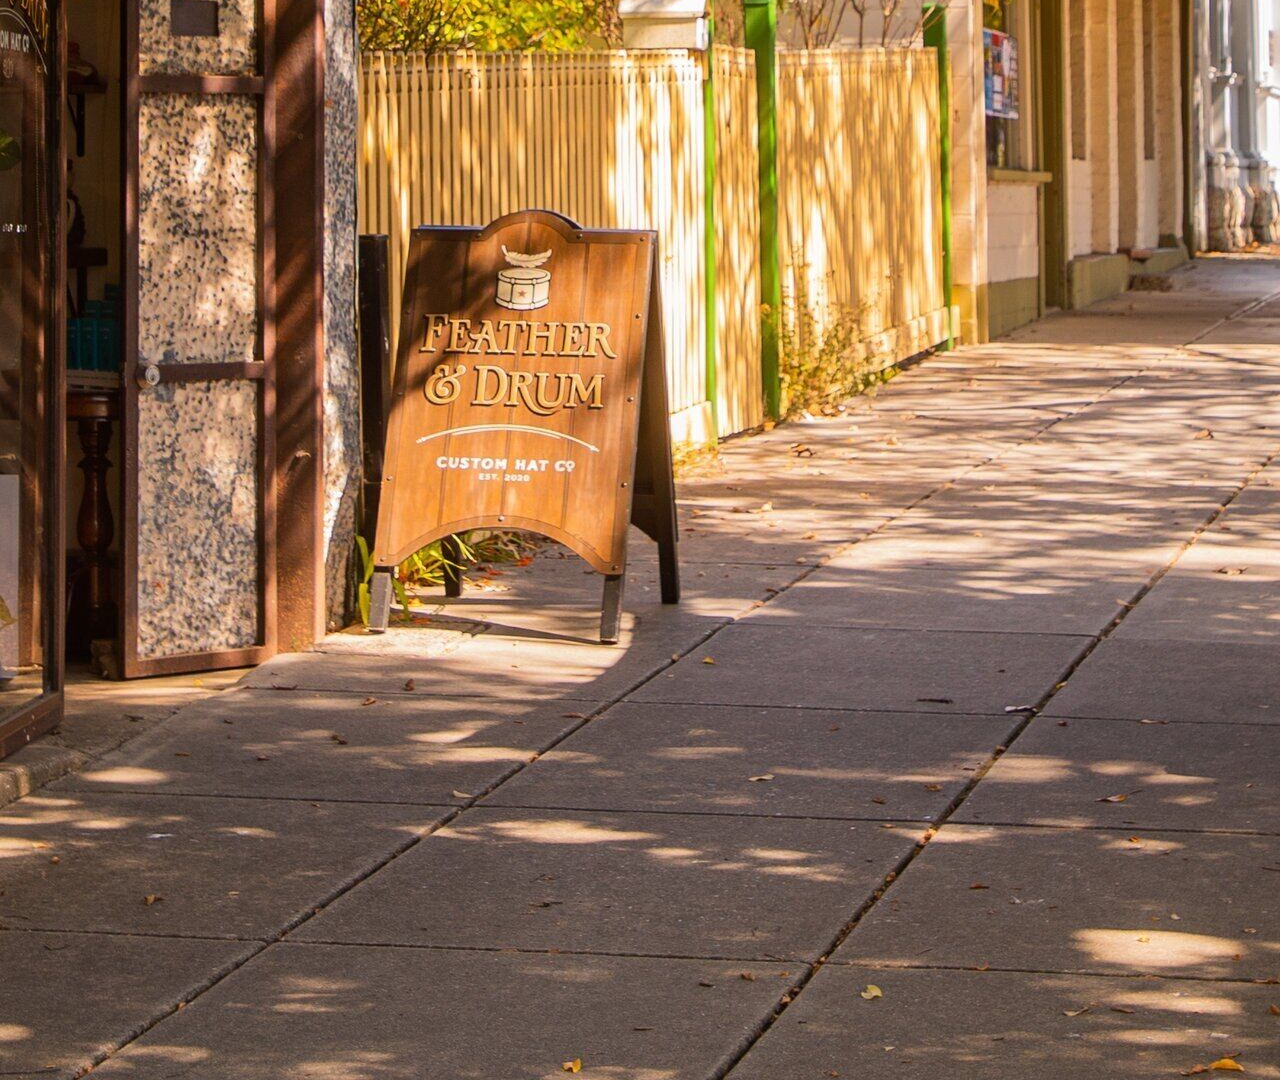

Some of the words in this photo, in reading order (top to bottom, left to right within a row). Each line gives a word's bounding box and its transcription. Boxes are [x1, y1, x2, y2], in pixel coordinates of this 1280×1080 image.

[419, 313, 617, 360] FEATHER
[424, 364, 468, 406] &
[470, 365, 605, 417] DRUM
[436, 456, 507, 471] CUSTOM
[515, 458, 550, 472] HAT
[478, 473, 499, 481] EST.
[503, 473, 531, 482] 2020
